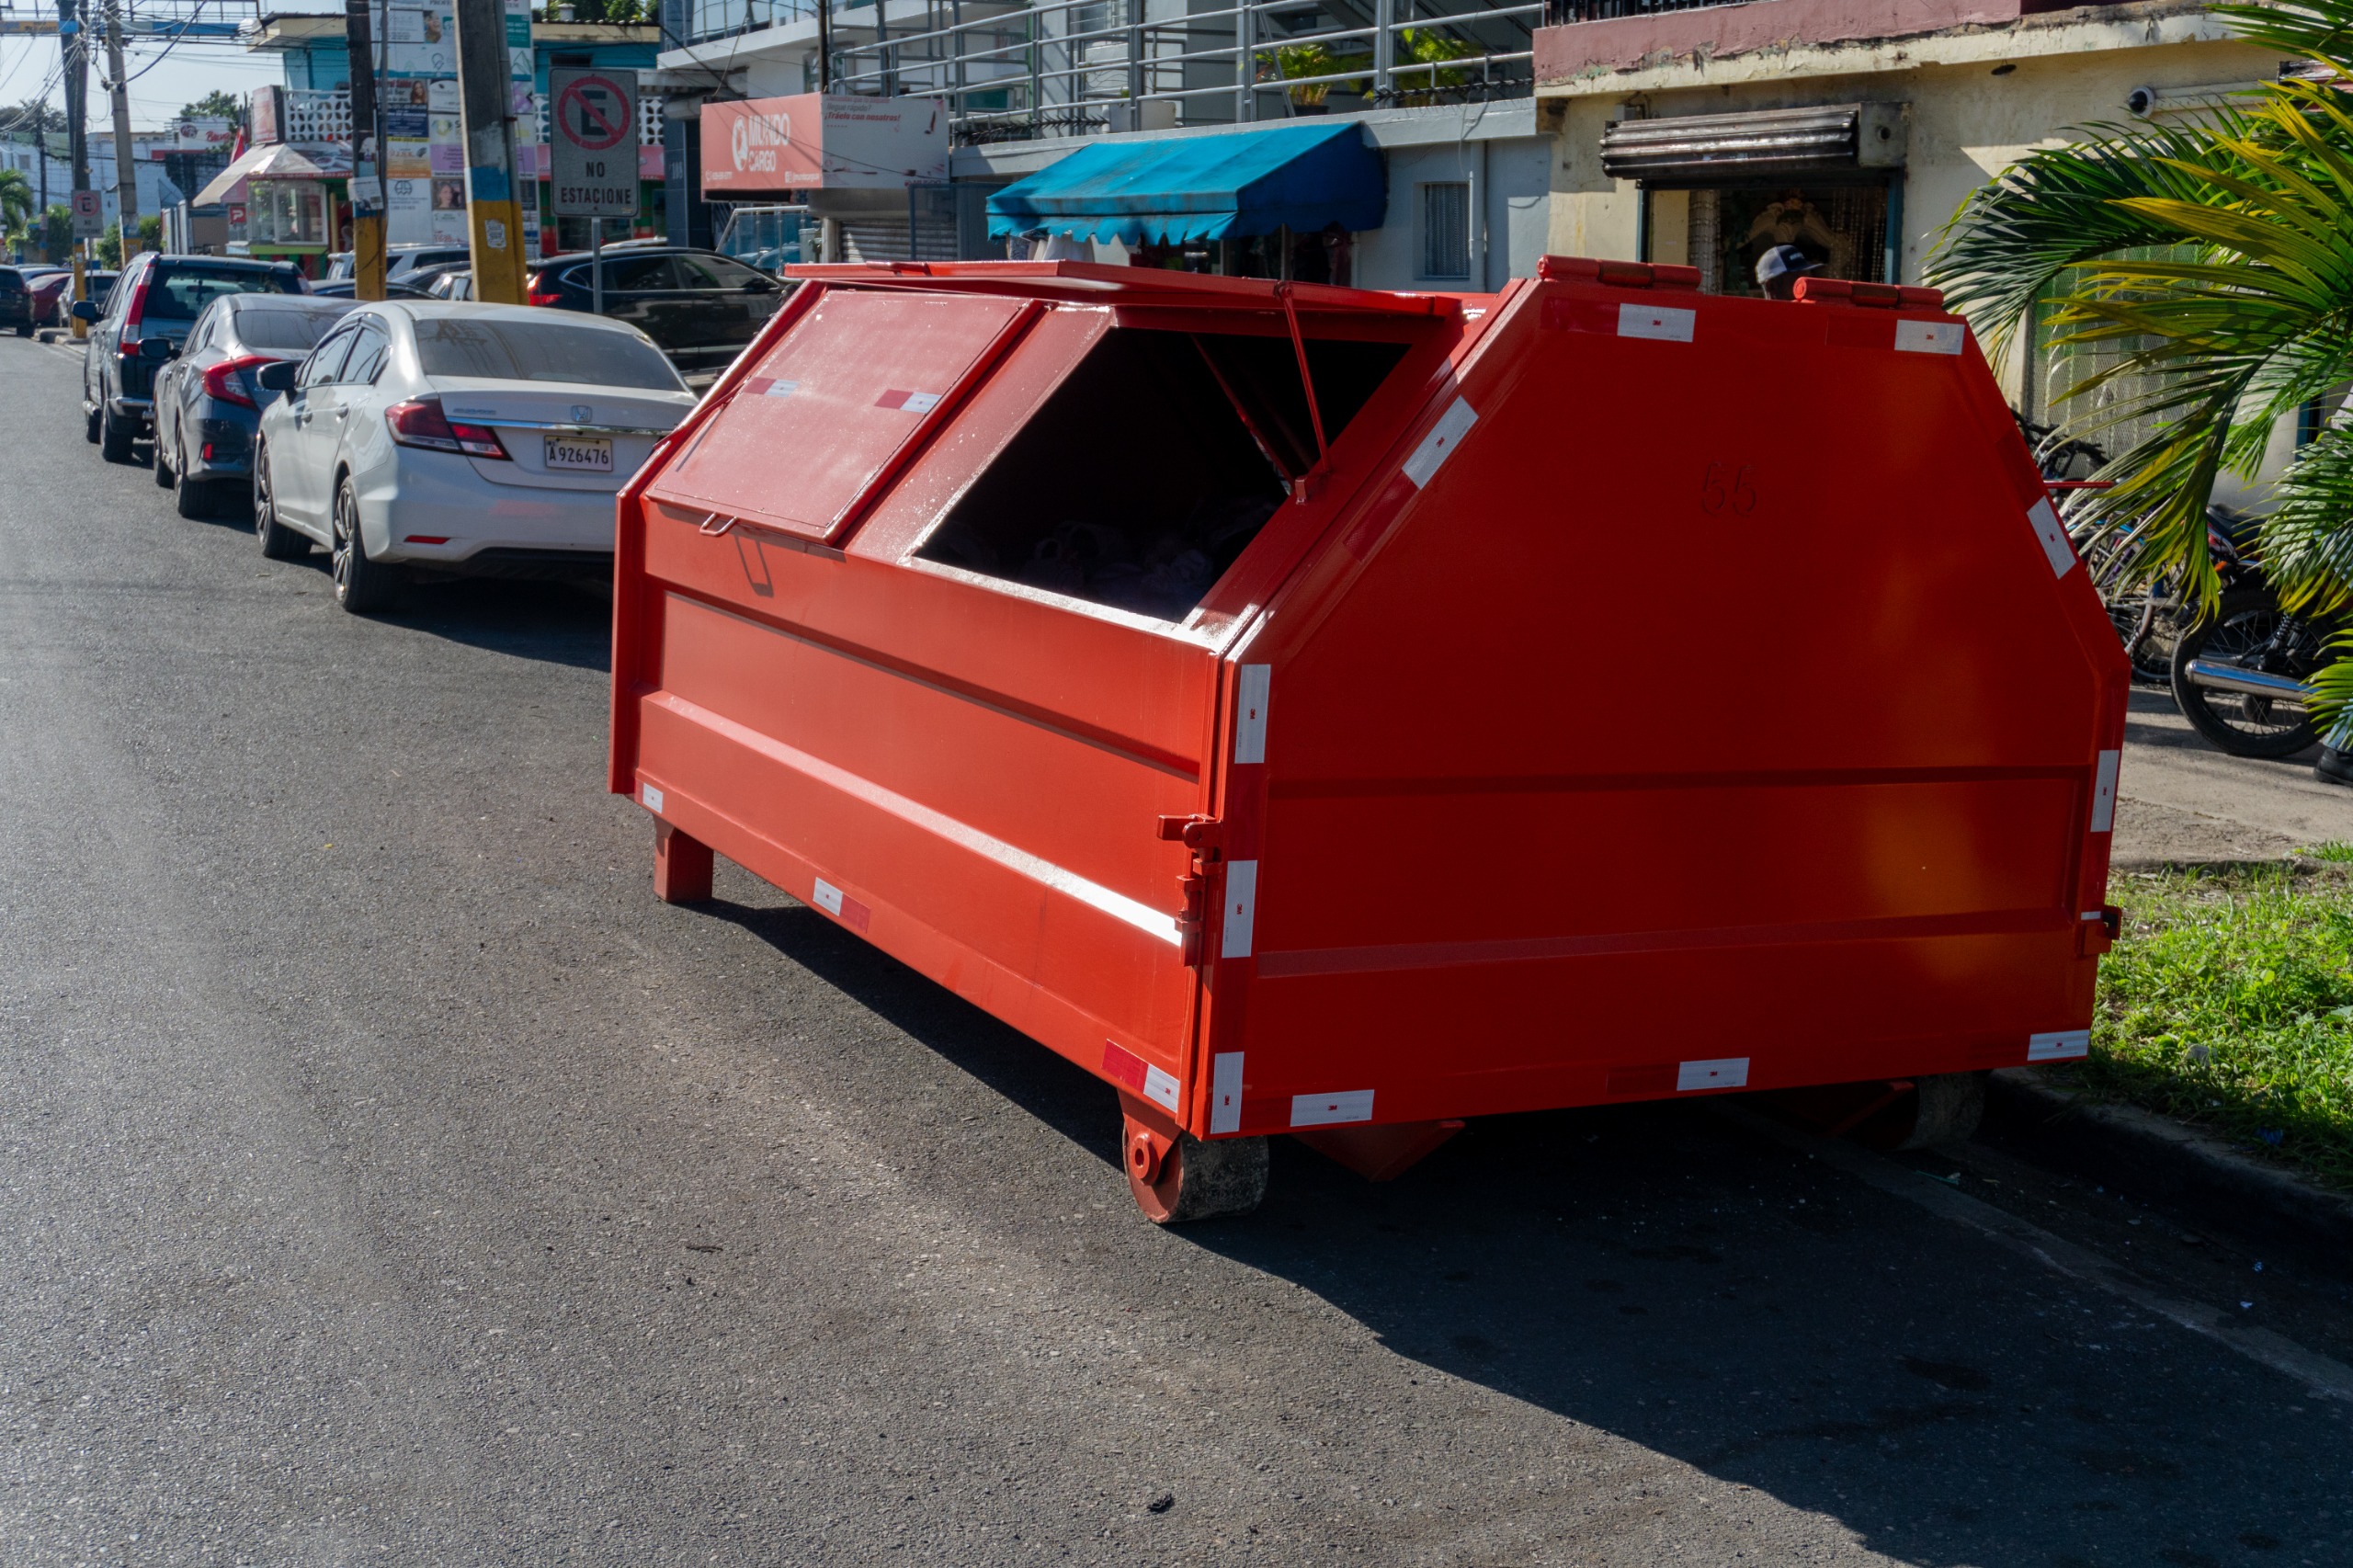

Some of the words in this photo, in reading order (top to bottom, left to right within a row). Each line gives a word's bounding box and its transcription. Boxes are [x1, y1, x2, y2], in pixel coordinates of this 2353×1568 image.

[748, 113, 790, 146] MUNDO
[585, 162, 606, 177] NO
[748, 149, 777, 172] CARGO
[561, 187, 631, 204] ESTACIONE
[549, 446, 609, 464] A926476
